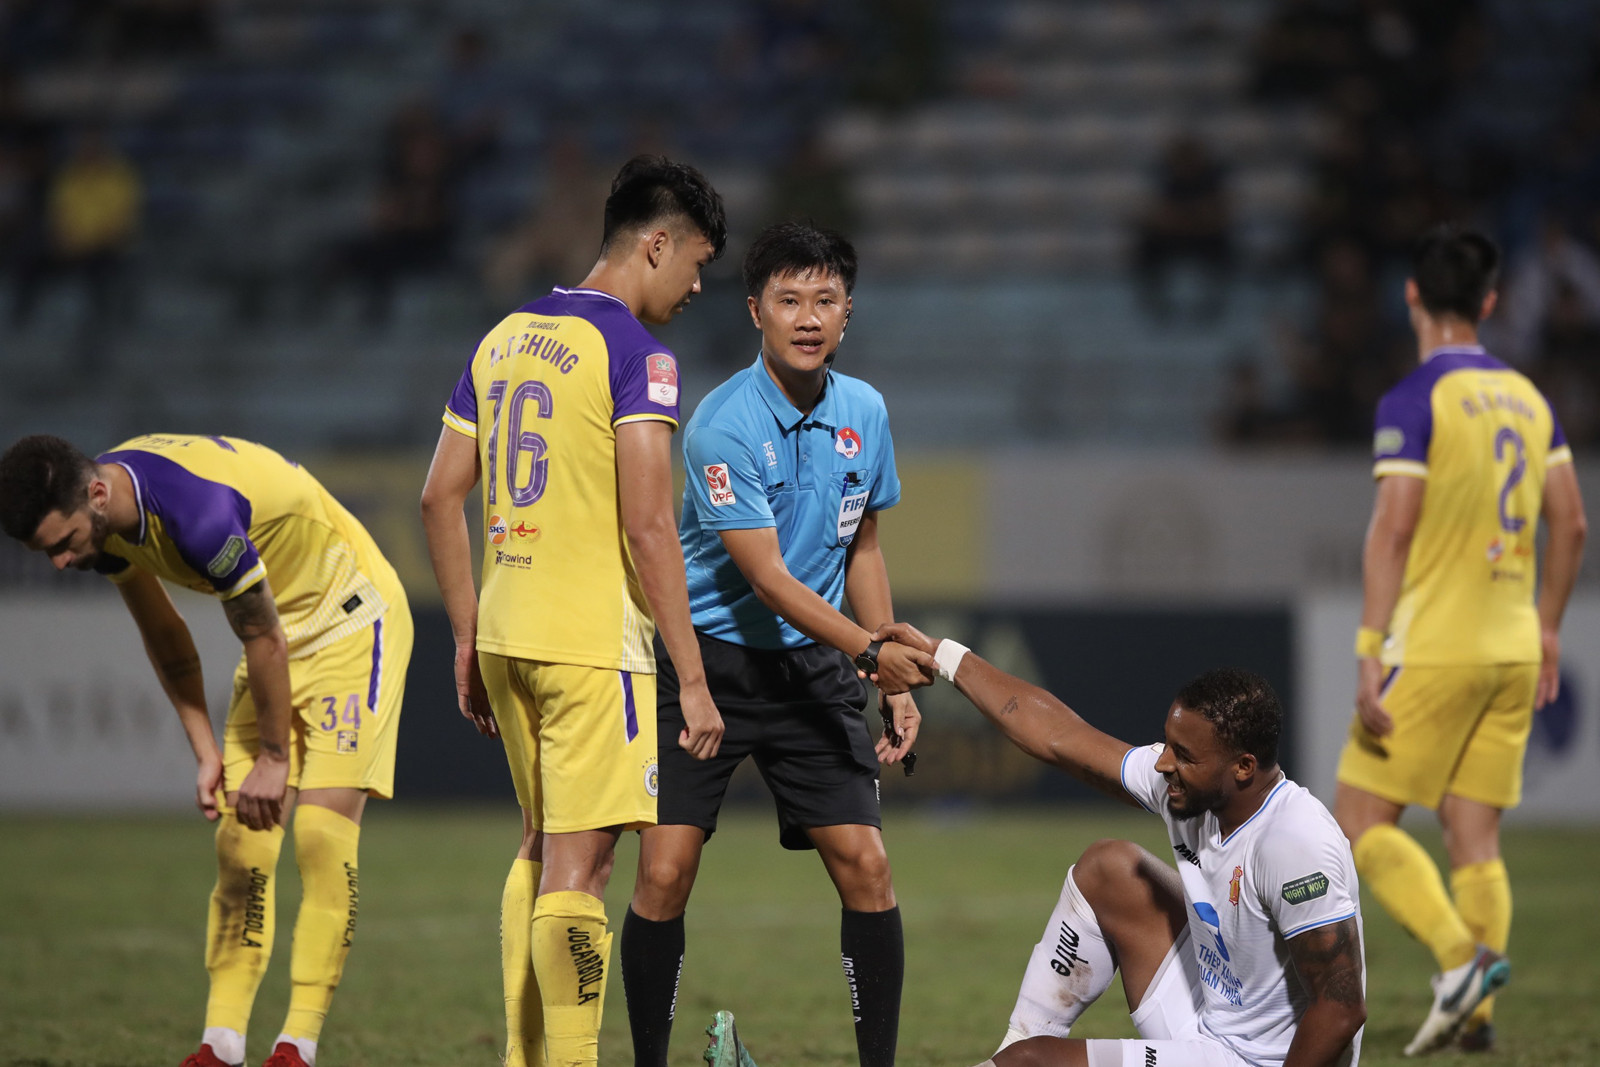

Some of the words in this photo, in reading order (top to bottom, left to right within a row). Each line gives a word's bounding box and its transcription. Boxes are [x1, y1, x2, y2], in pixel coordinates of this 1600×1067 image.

[487, 380, 554, 507] 16
[712, 491, 733, 503] VPF
[1494, 427, 1527, 534] 2
[840, 516, 862, 528] REFERE
[843, 496, 866, 513] FIFA
[489, 526, 505, 534] SHS
[321, 694, 361, 732] 34
[241, 867, 269, 949] JOGARBOLA
[1284, 886, 1307, 901] NIGHT
[1306, 879, 1326, 896] WOLF
[567, 926, 604, 1006] JOGARBOLA
[1050, 920, 1088, 977] mitre
[1199, 943, 1221, 970] THÉP
[1220, 962, 1243, 989] XANH
